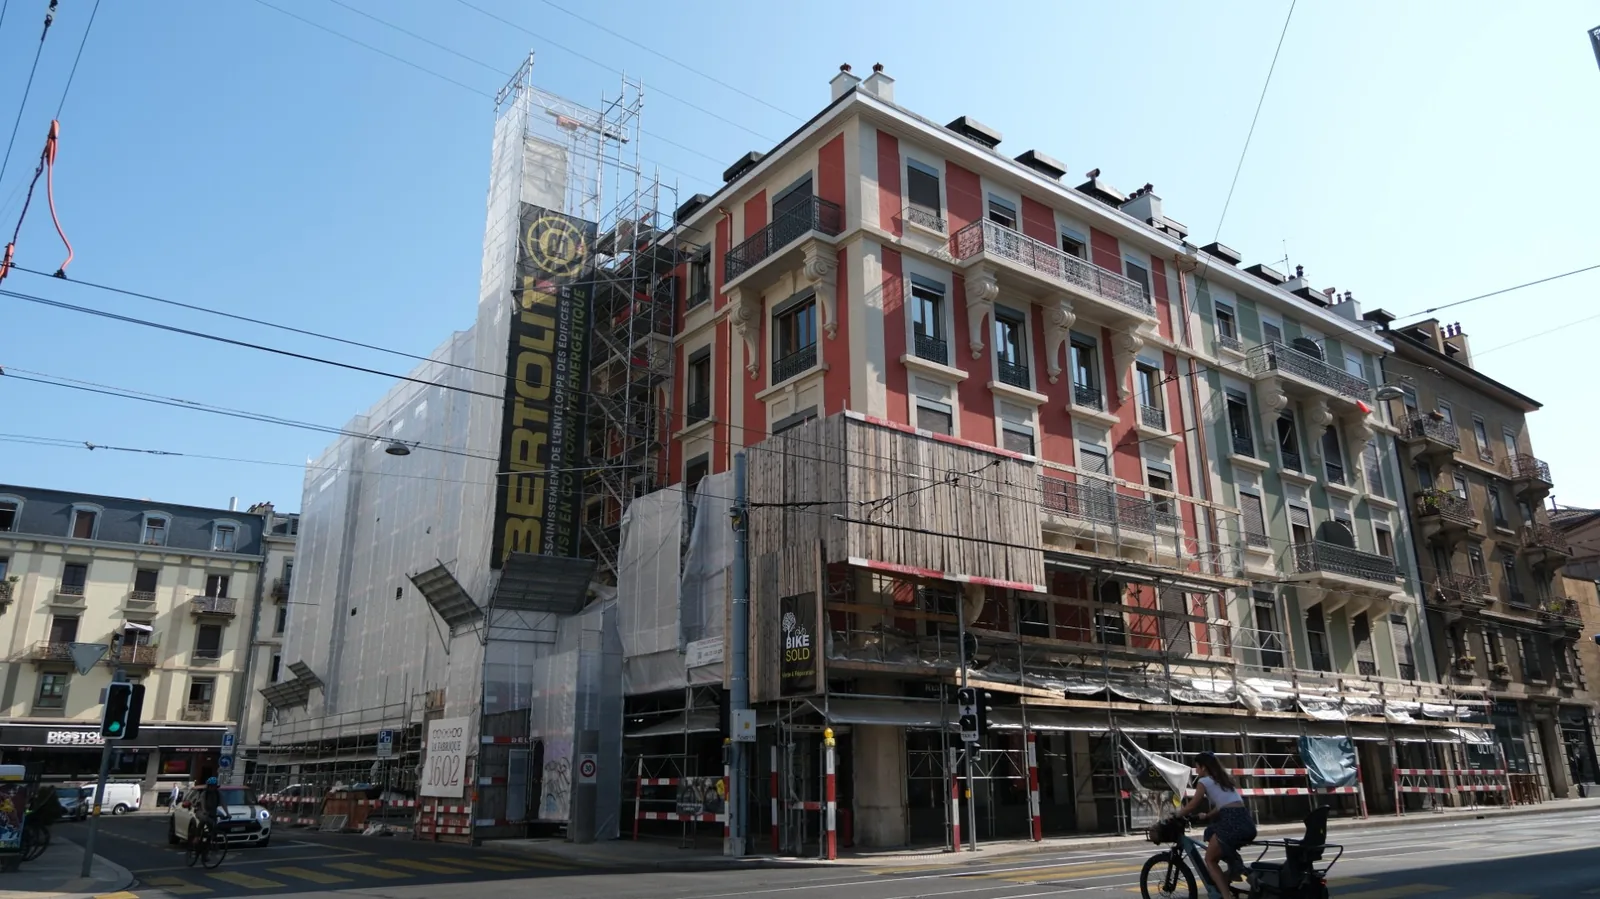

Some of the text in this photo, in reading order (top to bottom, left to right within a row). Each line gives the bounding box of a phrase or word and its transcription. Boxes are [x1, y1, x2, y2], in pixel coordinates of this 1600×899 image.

[566, 288, 585, 390] ÉNERGÉTIQUE
[503, 276, 557, 562] BERTOLIT
[543, 285, 571, 557] SSAINISSEMENT DE L'ENVELOPPE DES ÉDIFICES ET
[562, 390, 579, 497] CONFORMITÉ
[559, 501, 572, 522] EN
[786, 635, 810, 649] BIKE
[786, 648, 810, 662] SOLD
[381, 731, 387, 739] P
[427, 754, 461, 787] 1602
[584, 764, 593, 773] 30
